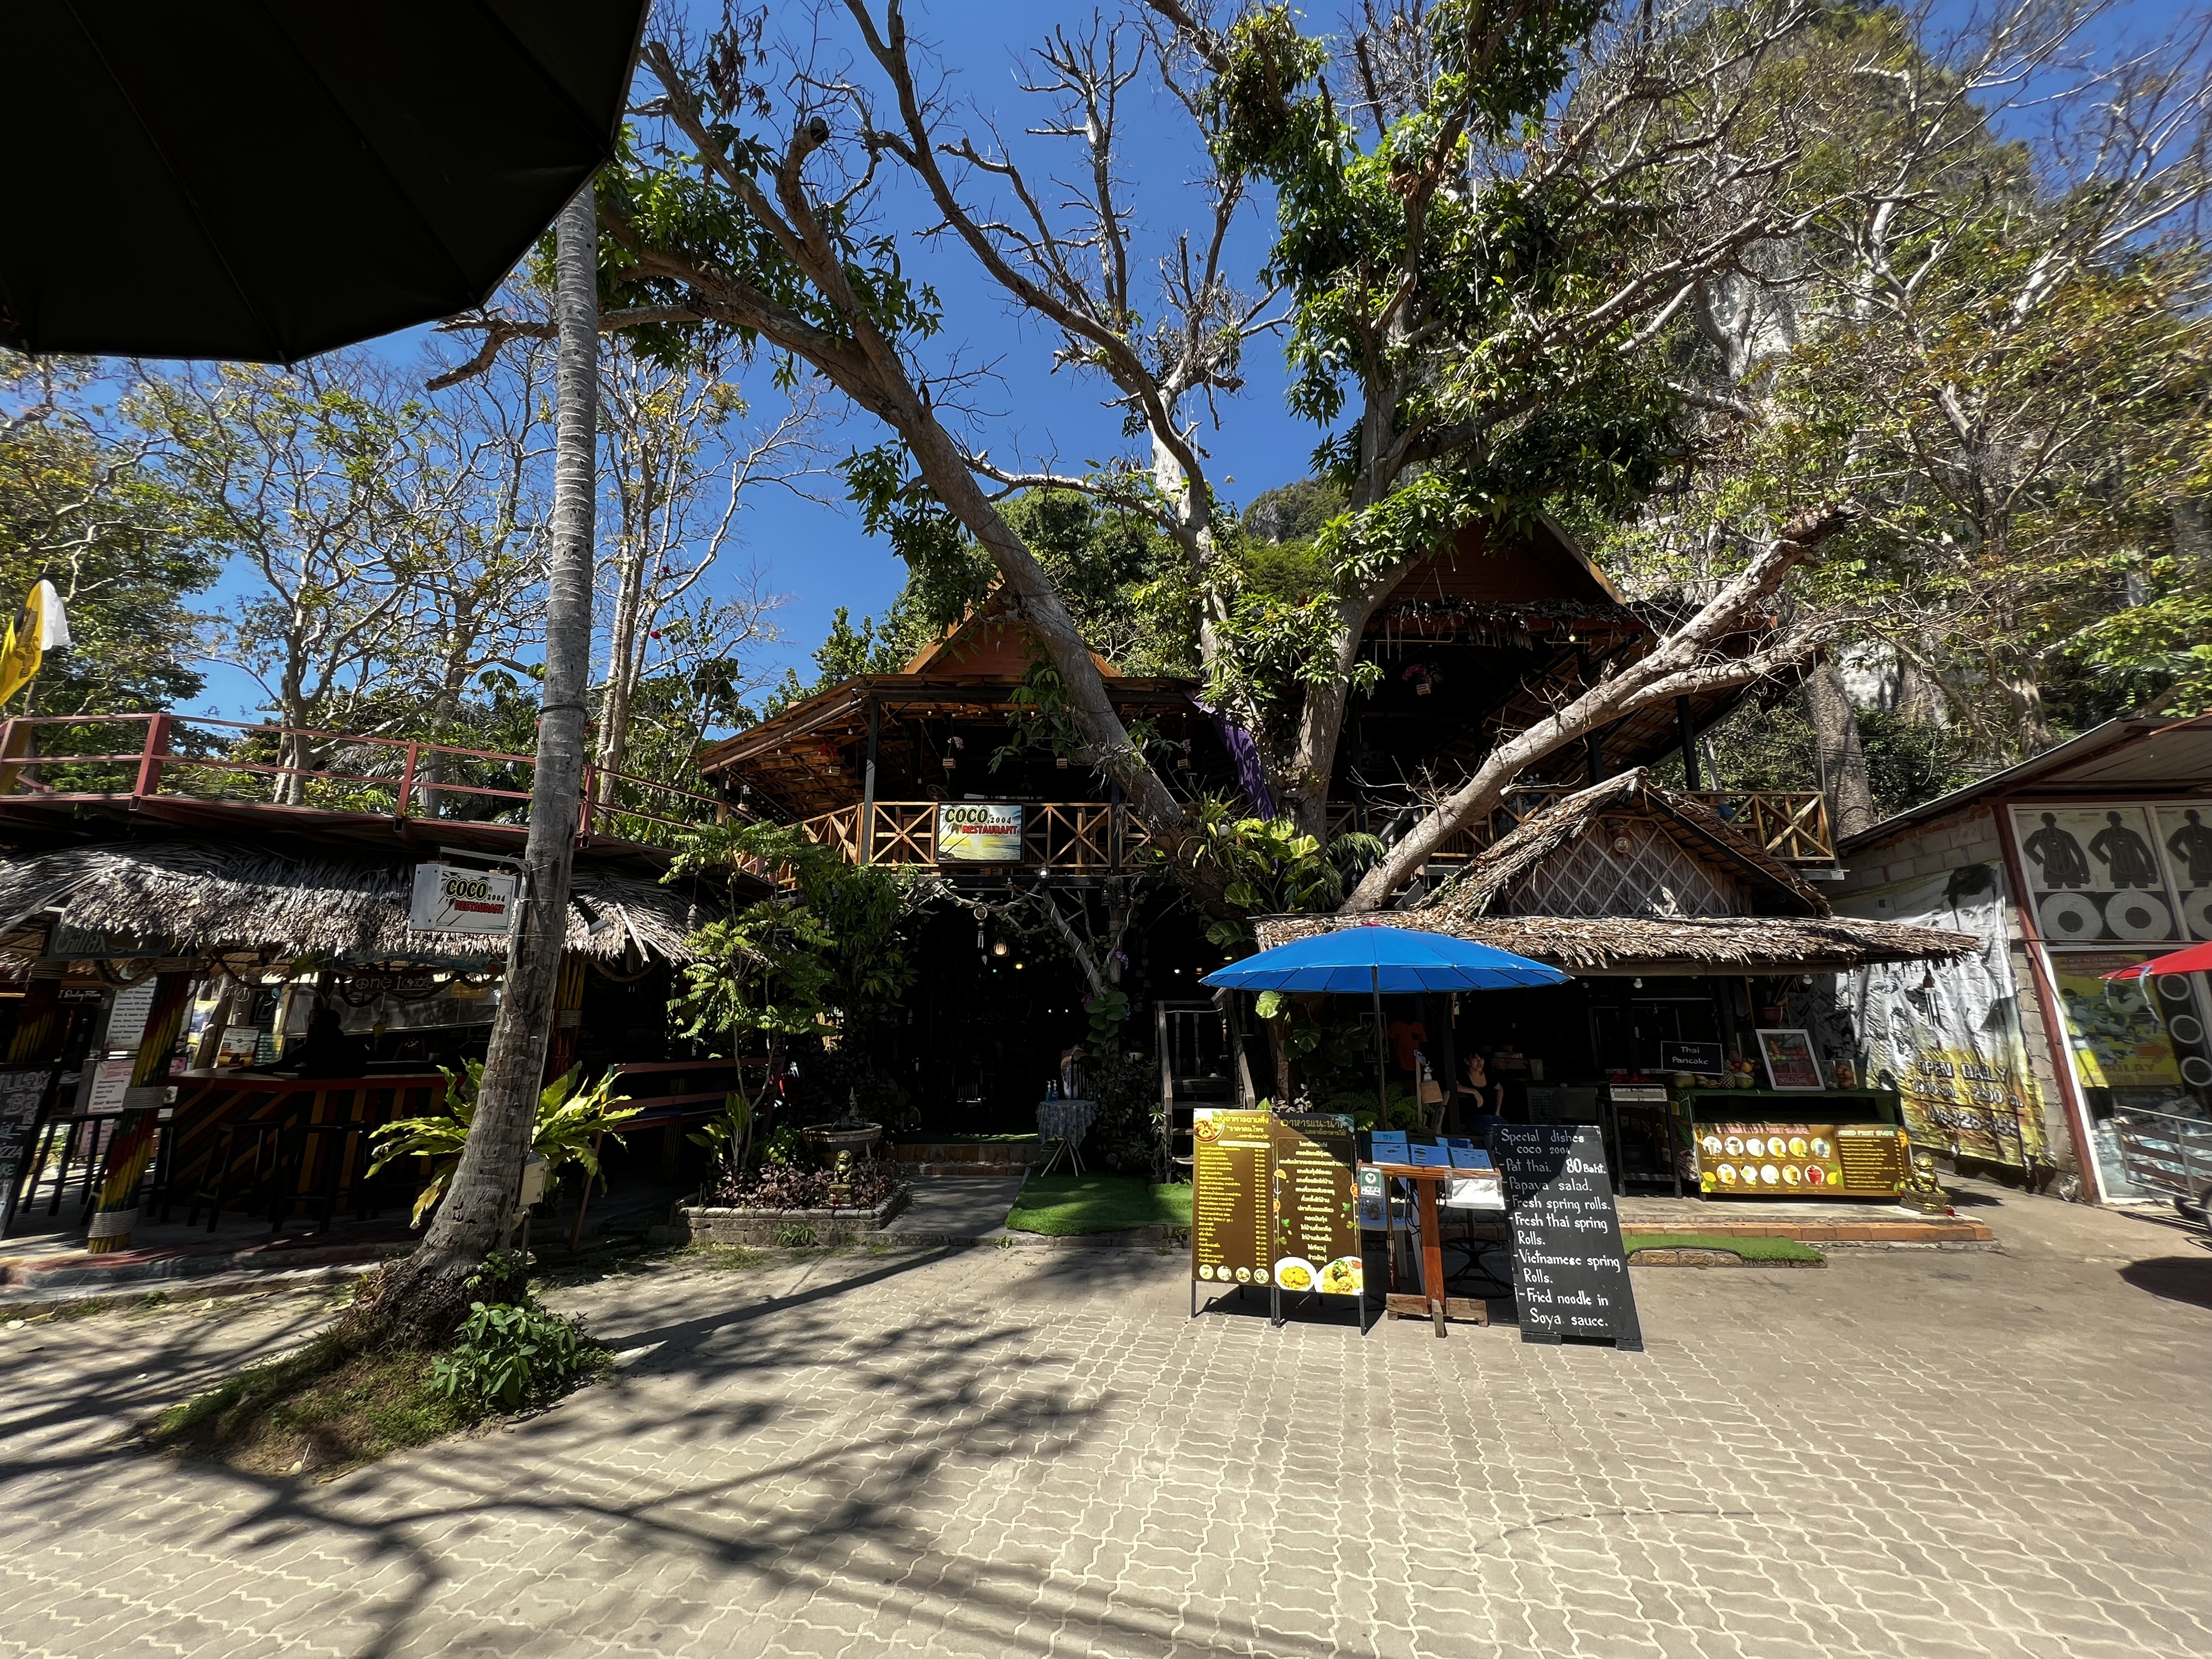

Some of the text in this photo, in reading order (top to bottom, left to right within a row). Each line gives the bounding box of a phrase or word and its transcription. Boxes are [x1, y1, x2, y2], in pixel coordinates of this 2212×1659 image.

[944, 807, 989, 823] COCO
[962, 825, 1018, 834] RESTAURANT
[445, 878, 488, 899] COCO
[455, 900, 505, 914] RESTAURANT
[1672, 1056, 1708, 1065] Pancake
[1213, 1114, 1269, 1124] เมนูอาหารตามสั่ง
[1501, 1129, 1584, 1146] Special dishes
[1550, 1146, 1570, 1155] 2004
[1566, 1157, 1582, 1173] 80
[1558, 1178, 1593, 1191] salad.
[1546, 1198, 1580, 1214] spring
[1585, 1197, 1611, 1210] rolls.
[1546, 1213, 1570, 1228] thai
[1574, 1217, 1608, 1234] spring
[1517, 1230, 1546, 1245] Rolls.
[1587, 1255, 1620, 1272] spring
[1523, 1268, 1553, 1284] Rolls.
[1557, 1290, 1592, 1305] noodle
[1597, 1294, 1609, 1306] in
[1571, 1316, 1608, 1327] sauce.
